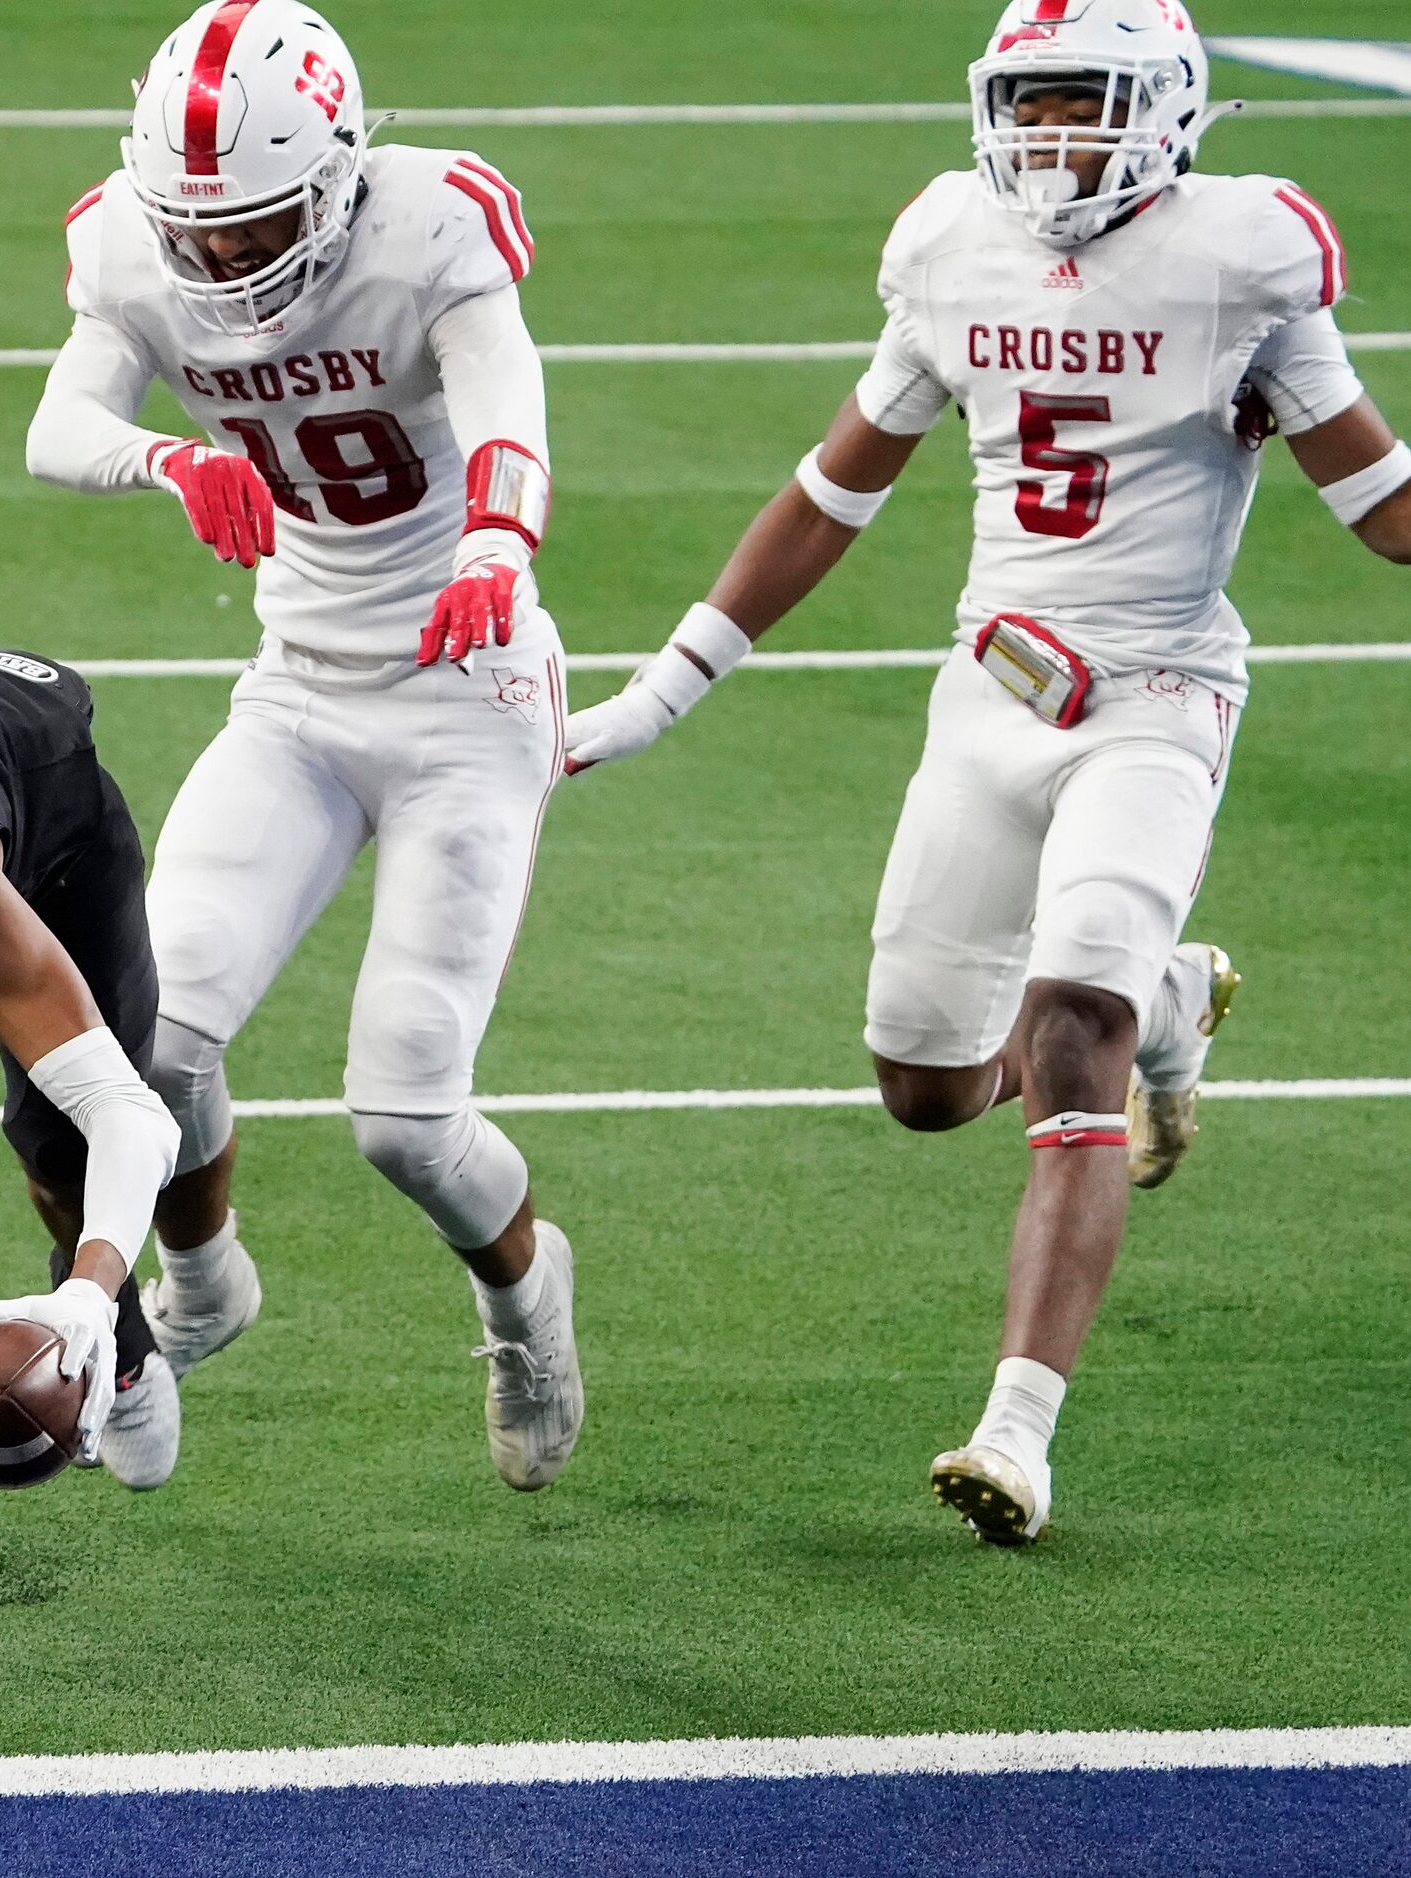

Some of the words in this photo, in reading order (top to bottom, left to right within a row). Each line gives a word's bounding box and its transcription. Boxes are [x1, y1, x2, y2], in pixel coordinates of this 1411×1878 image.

[179, 181, 225, 196] EAT-TNT
[1041, 277, 1085, 290] adidas
[182, 348, 387, 402] CROSBY
[968, 323, 1164, 375] CROSBY
[219, 408, 429, 526] 19
[1014, 389, 1112, 540] 5
